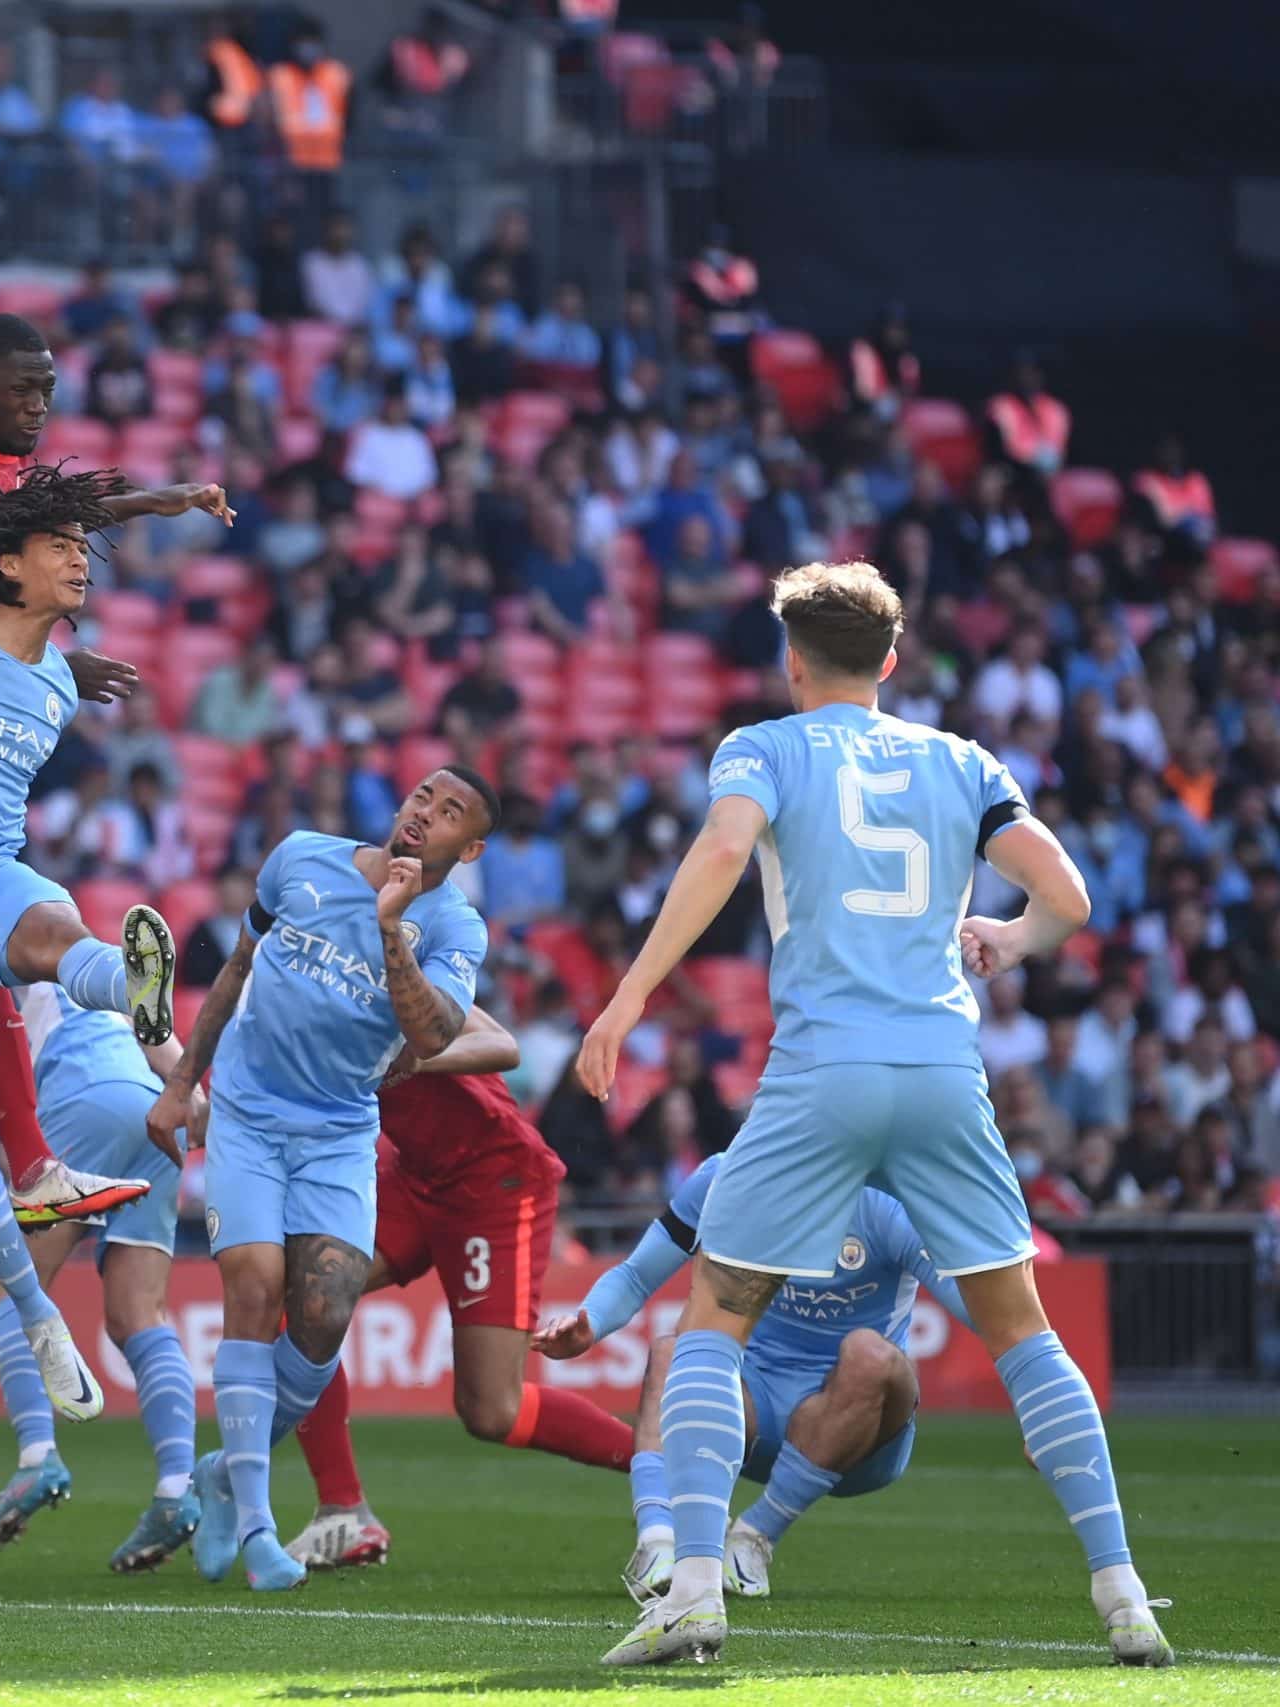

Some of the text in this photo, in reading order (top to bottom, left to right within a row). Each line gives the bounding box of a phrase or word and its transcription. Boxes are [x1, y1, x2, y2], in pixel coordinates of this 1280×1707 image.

[836, 765, 930, 918] 5
[287, 958, 375, 1005] AIRWAYS
[464, 1235, 492, 1292] 3
